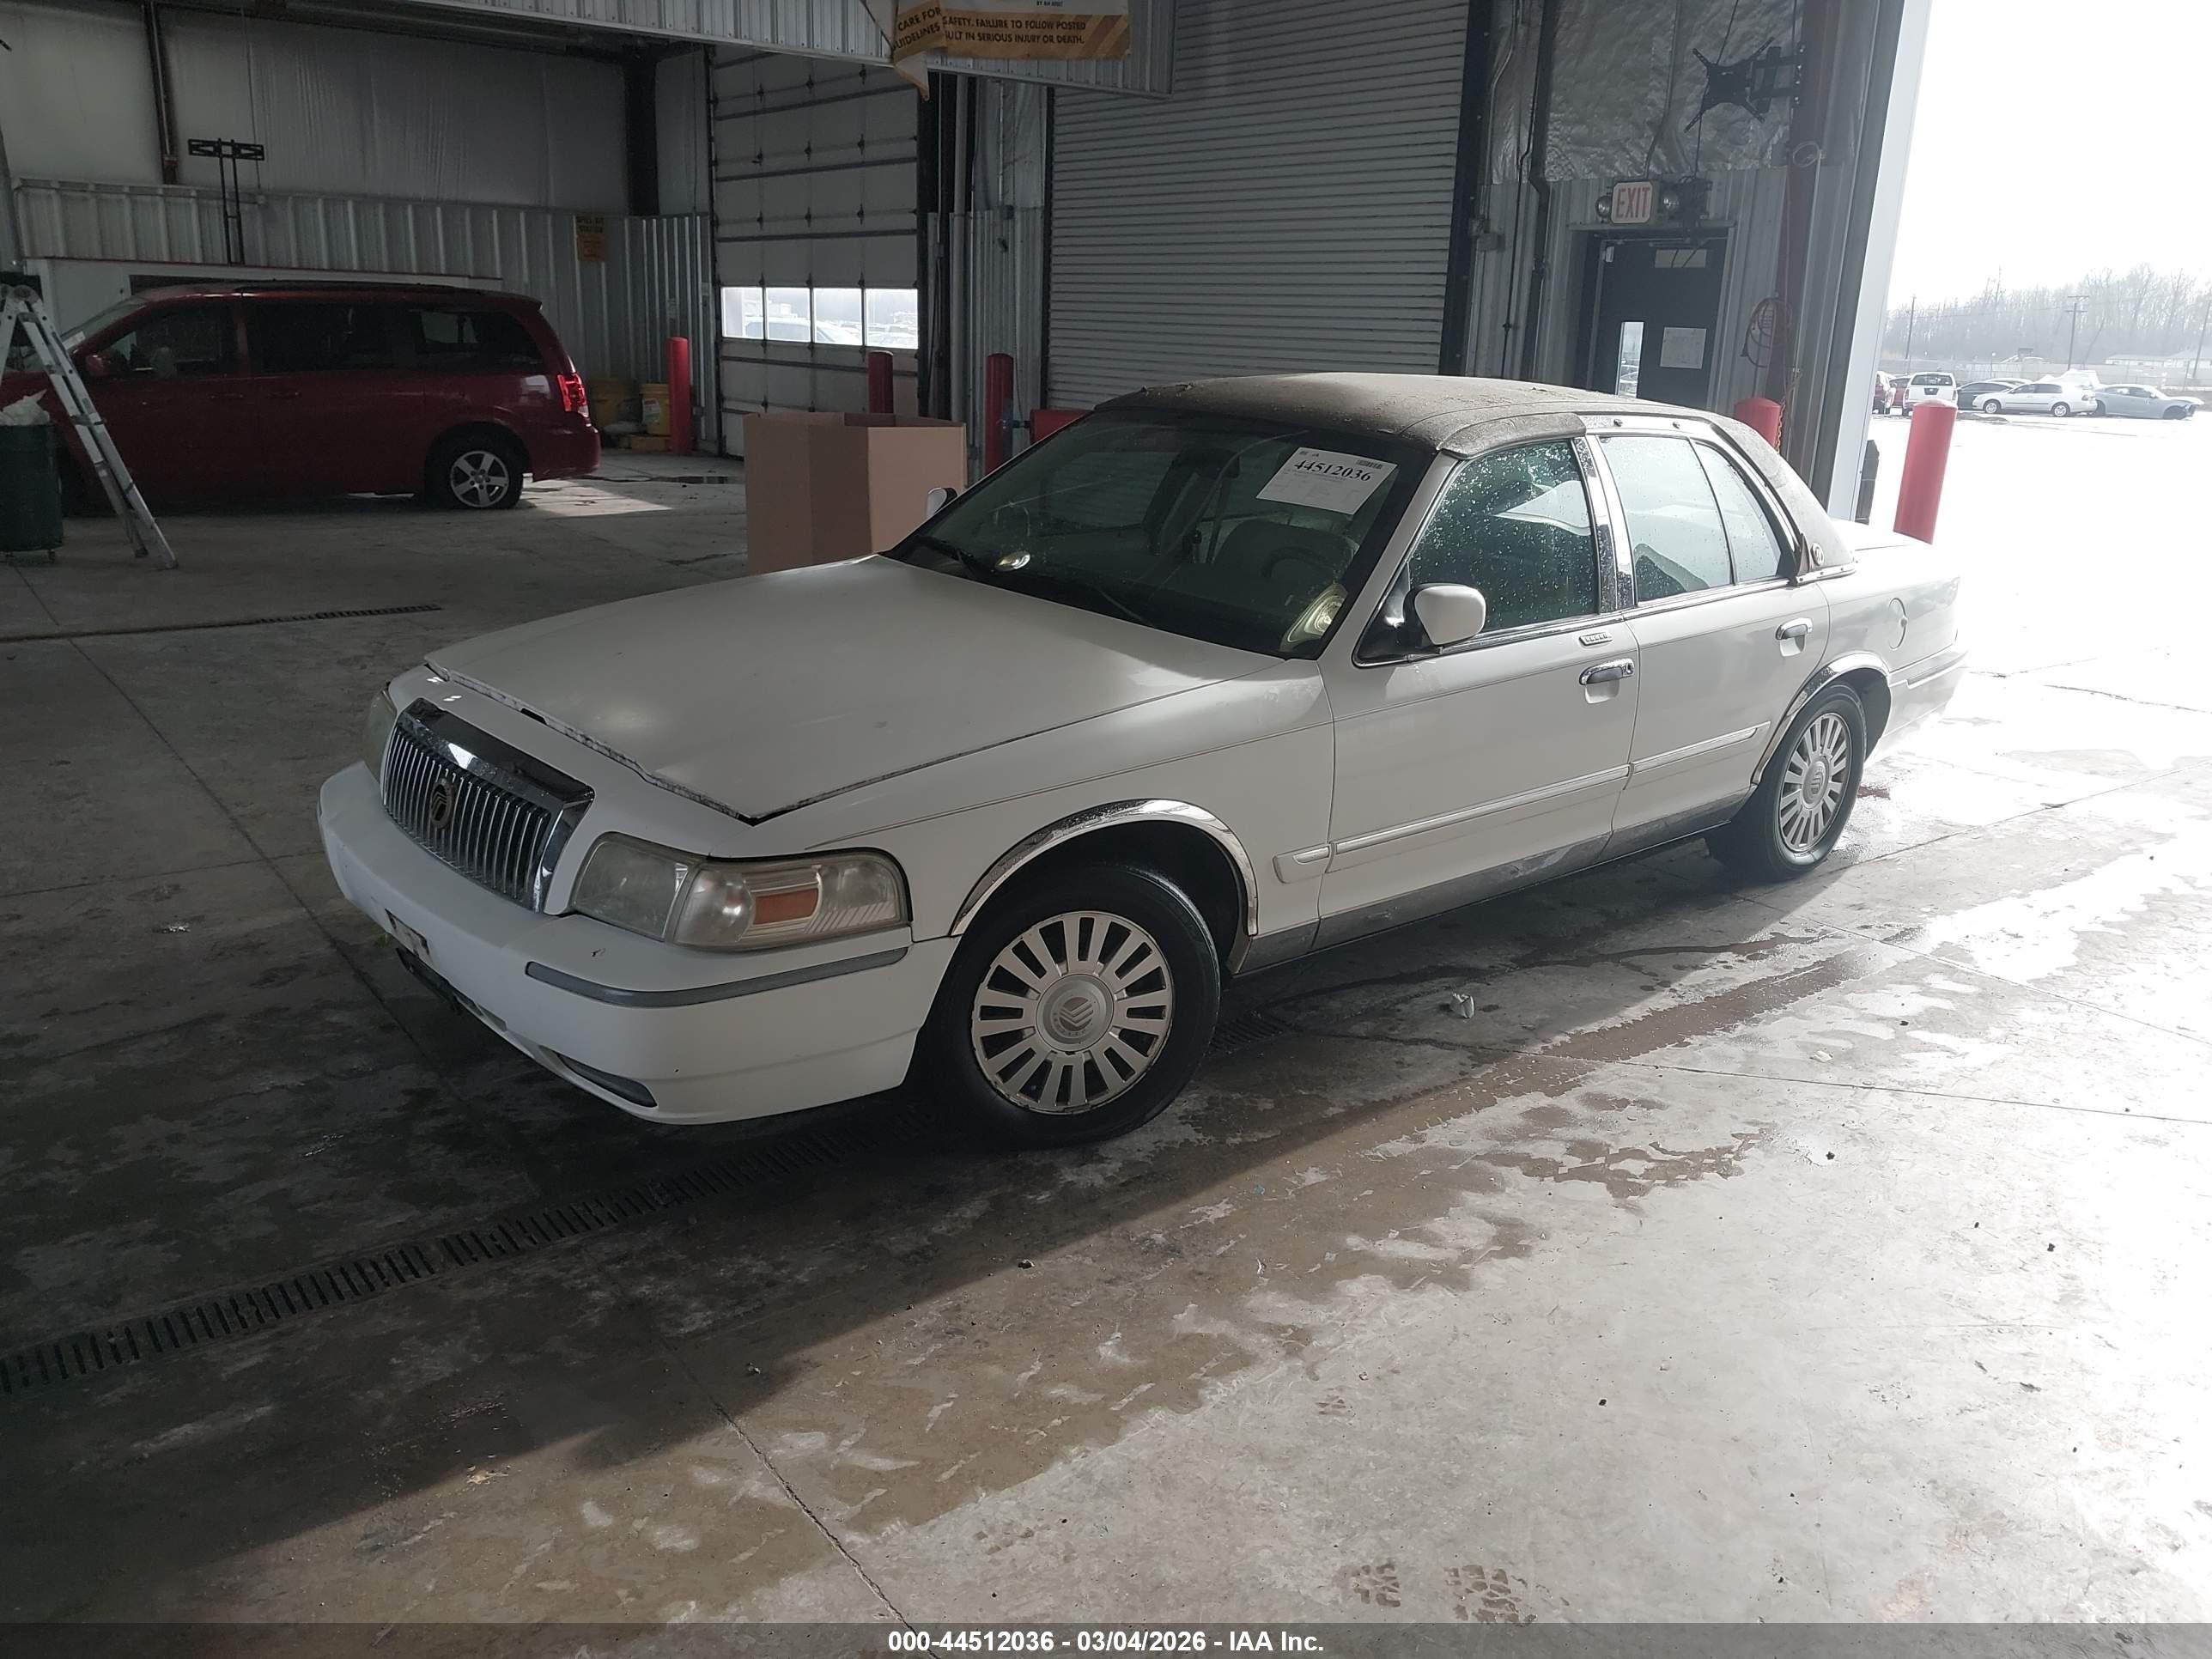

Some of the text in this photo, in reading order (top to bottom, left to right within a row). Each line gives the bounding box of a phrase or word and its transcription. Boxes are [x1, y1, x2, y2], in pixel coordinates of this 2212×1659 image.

[898, 14, 921, 31] CARE
[921, 7, 942, 21] FOR
[976, 19, 1008, 28] FAILURE
[1012, 20, 1023, 29] TO
[1025, 21, 1054, 30] FOLLOW
[1056, 21, 1086, 30] POSTED
[966, 31, 975, 40] IN
[977, 32, 1012, 42] SERIOUS
[1015, 33, 1040, 43] INJURY
[1042, 34, 1054, 43] OR
[1057, 34, 1085, 44] DEATH.
[1615, 186, 1650, 218] EXIT
[1293, 459, 1371, 481] 44512036
